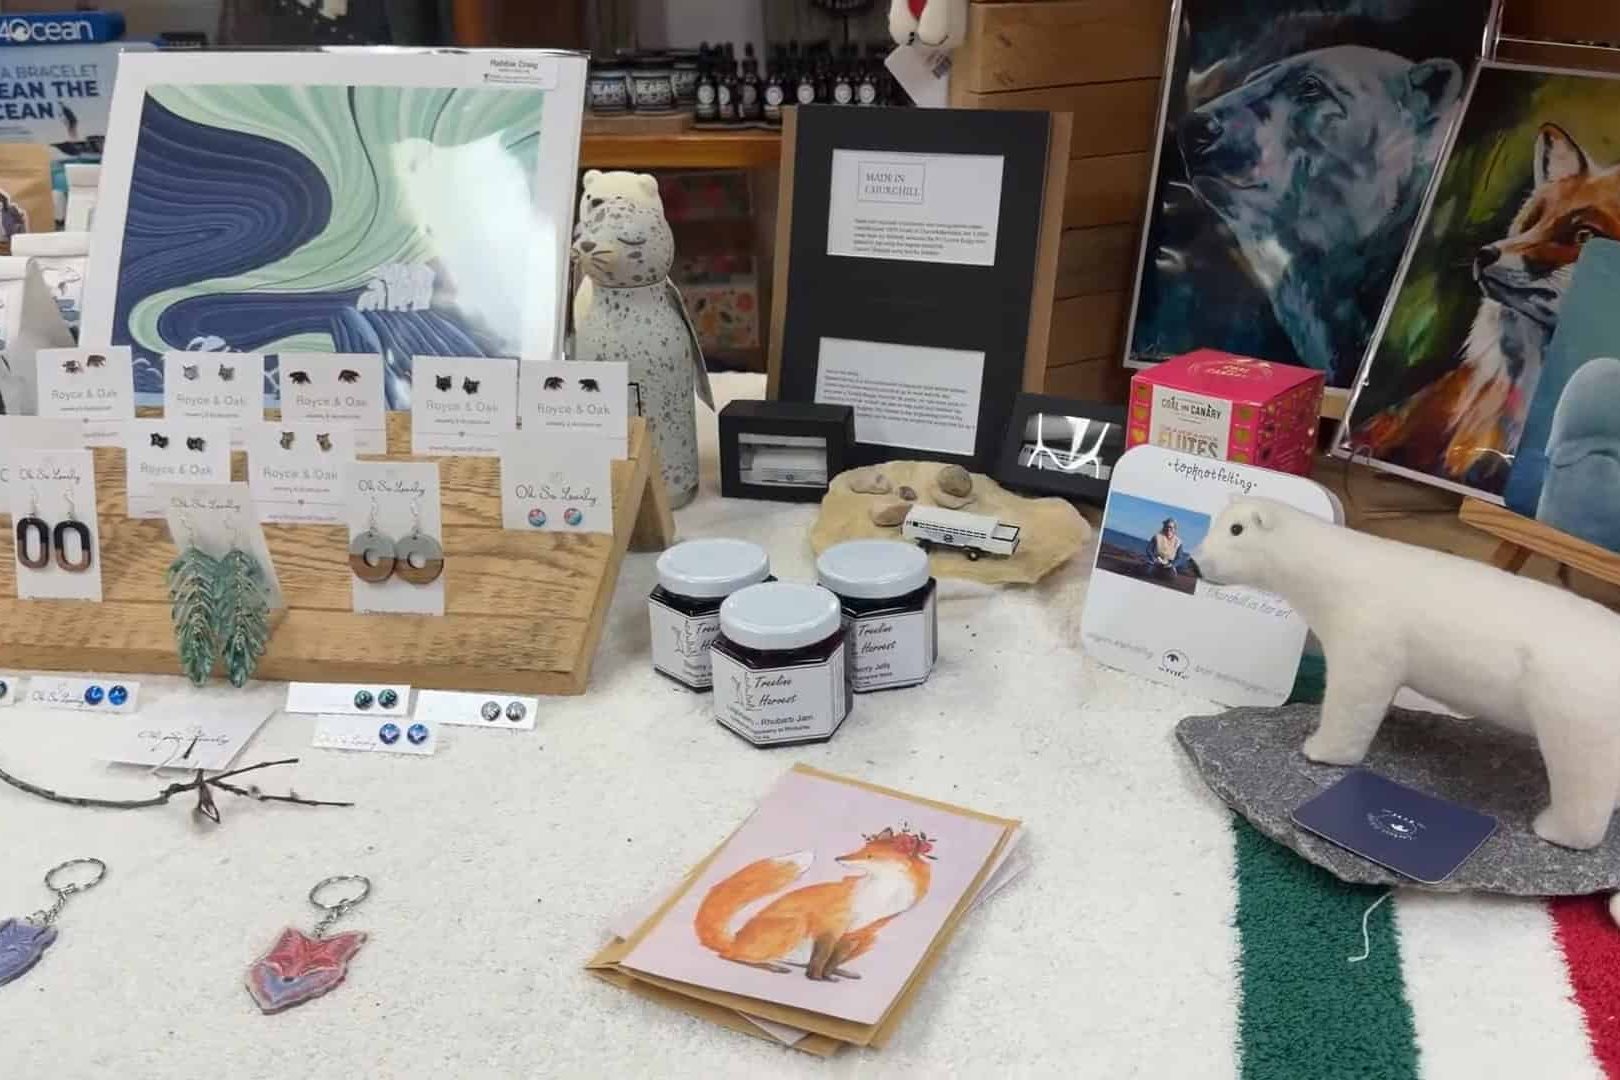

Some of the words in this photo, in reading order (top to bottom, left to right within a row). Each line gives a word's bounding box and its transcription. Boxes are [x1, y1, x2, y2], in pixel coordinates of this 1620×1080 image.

[16, 64, 98, 79] BRACELET
[51, 80, 99, 97] THE
[1191, 403, 1222, 420] CANARY
[754, 674, 792, 688] Treeline
[759, 694, 797, 706] Harvest
